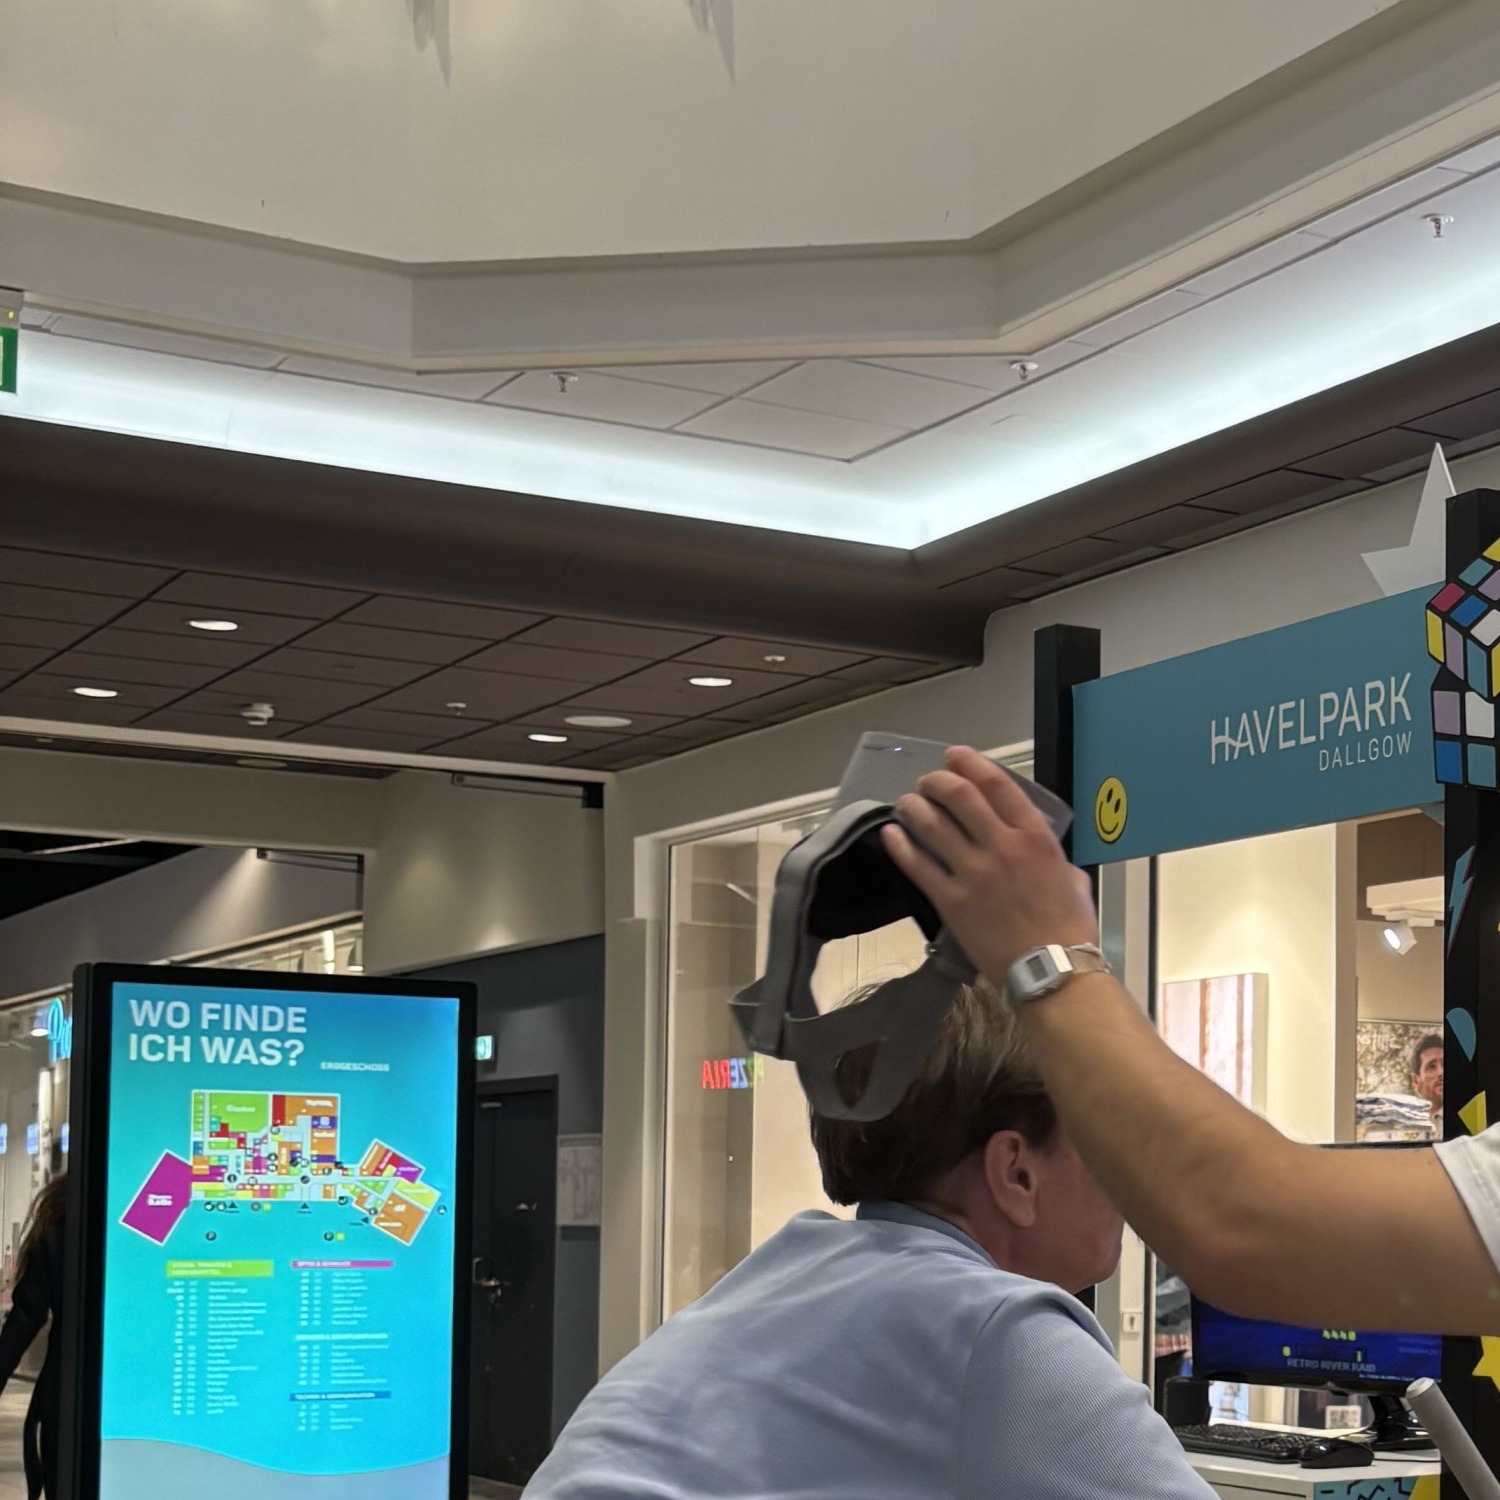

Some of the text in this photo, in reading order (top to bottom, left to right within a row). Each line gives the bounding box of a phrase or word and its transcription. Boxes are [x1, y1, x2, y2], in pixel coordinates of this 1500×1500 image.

[1211, 672, 1412, 764] HAVELPARK
[1319, 731, 1412, 772] DALLGOW
[130, 999, 307, 1034] WO FINDE
[129, 1034, 305, 1067] ICH WAS?
[1286, 1357, 1376, 1373] RETRO RIVER RAID
